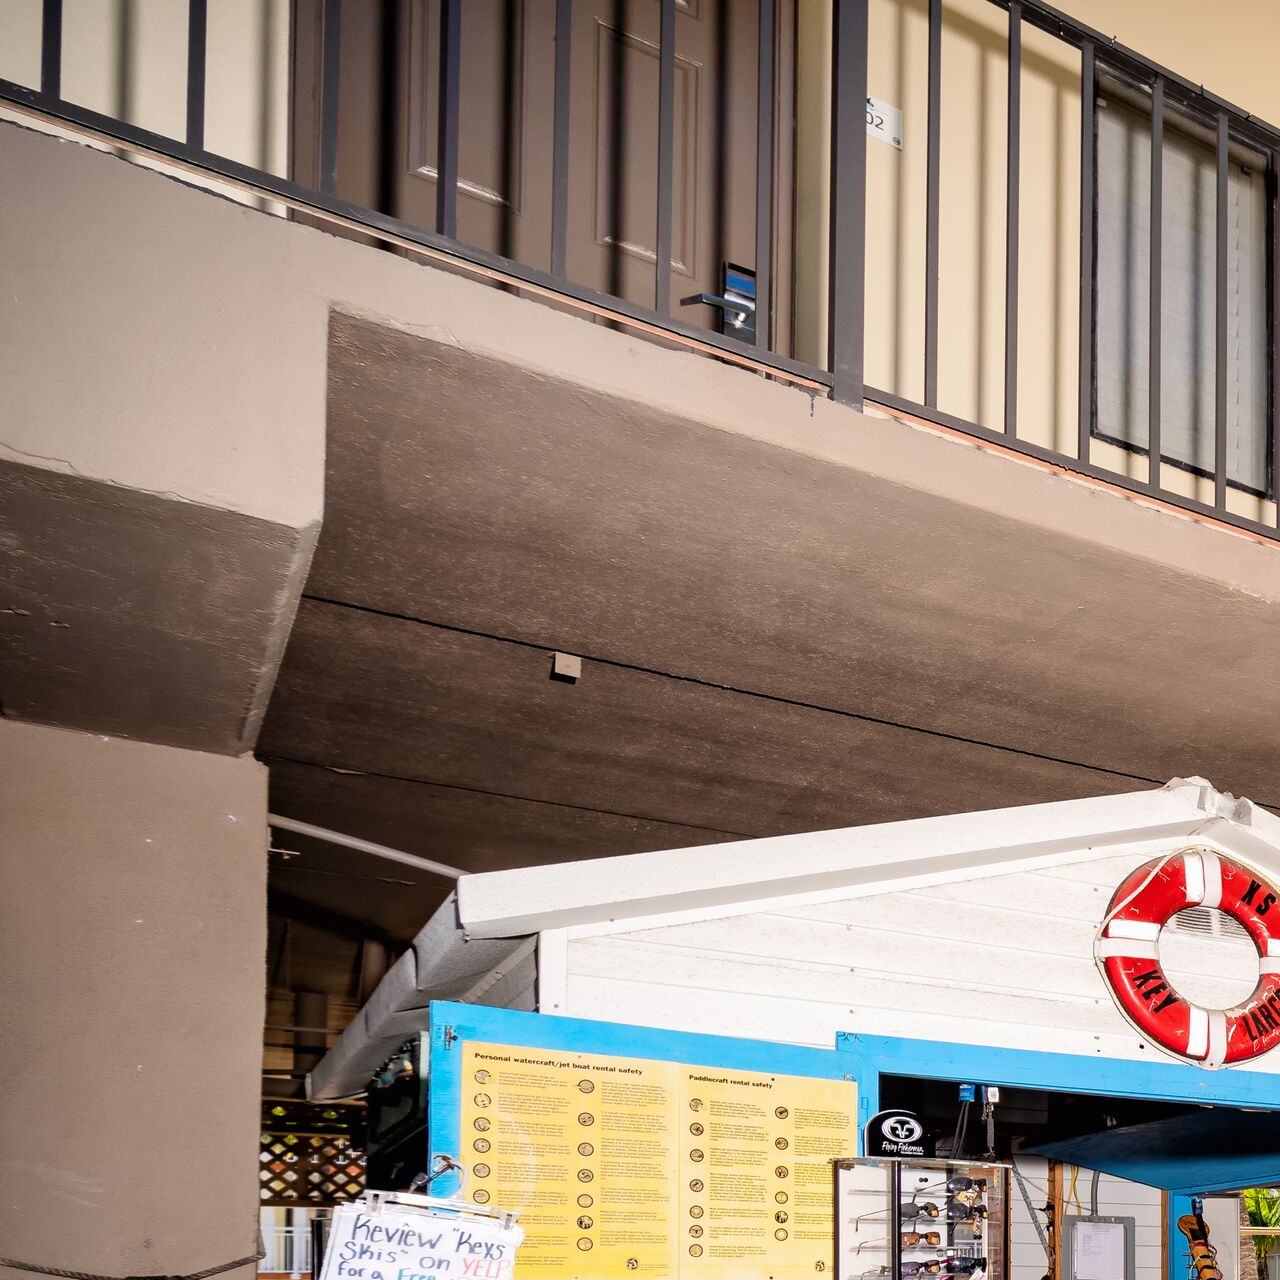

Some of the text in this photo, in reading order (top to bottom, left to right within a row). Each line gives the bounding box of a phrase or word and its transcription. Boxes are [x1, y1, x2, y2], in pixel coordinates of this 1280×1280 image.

[1131, 968, 1181, 1015] KEY
[474, 1052, 643, 1075] Personal watercraft/jet boat rental safety
[688, 1074, 774, 1089] Paddlecraft rental safety
[351, 1212, 444, 1250] Review
[370, 1270, 385, 1280] a
[462, 1257, 513, 1280] YELP
